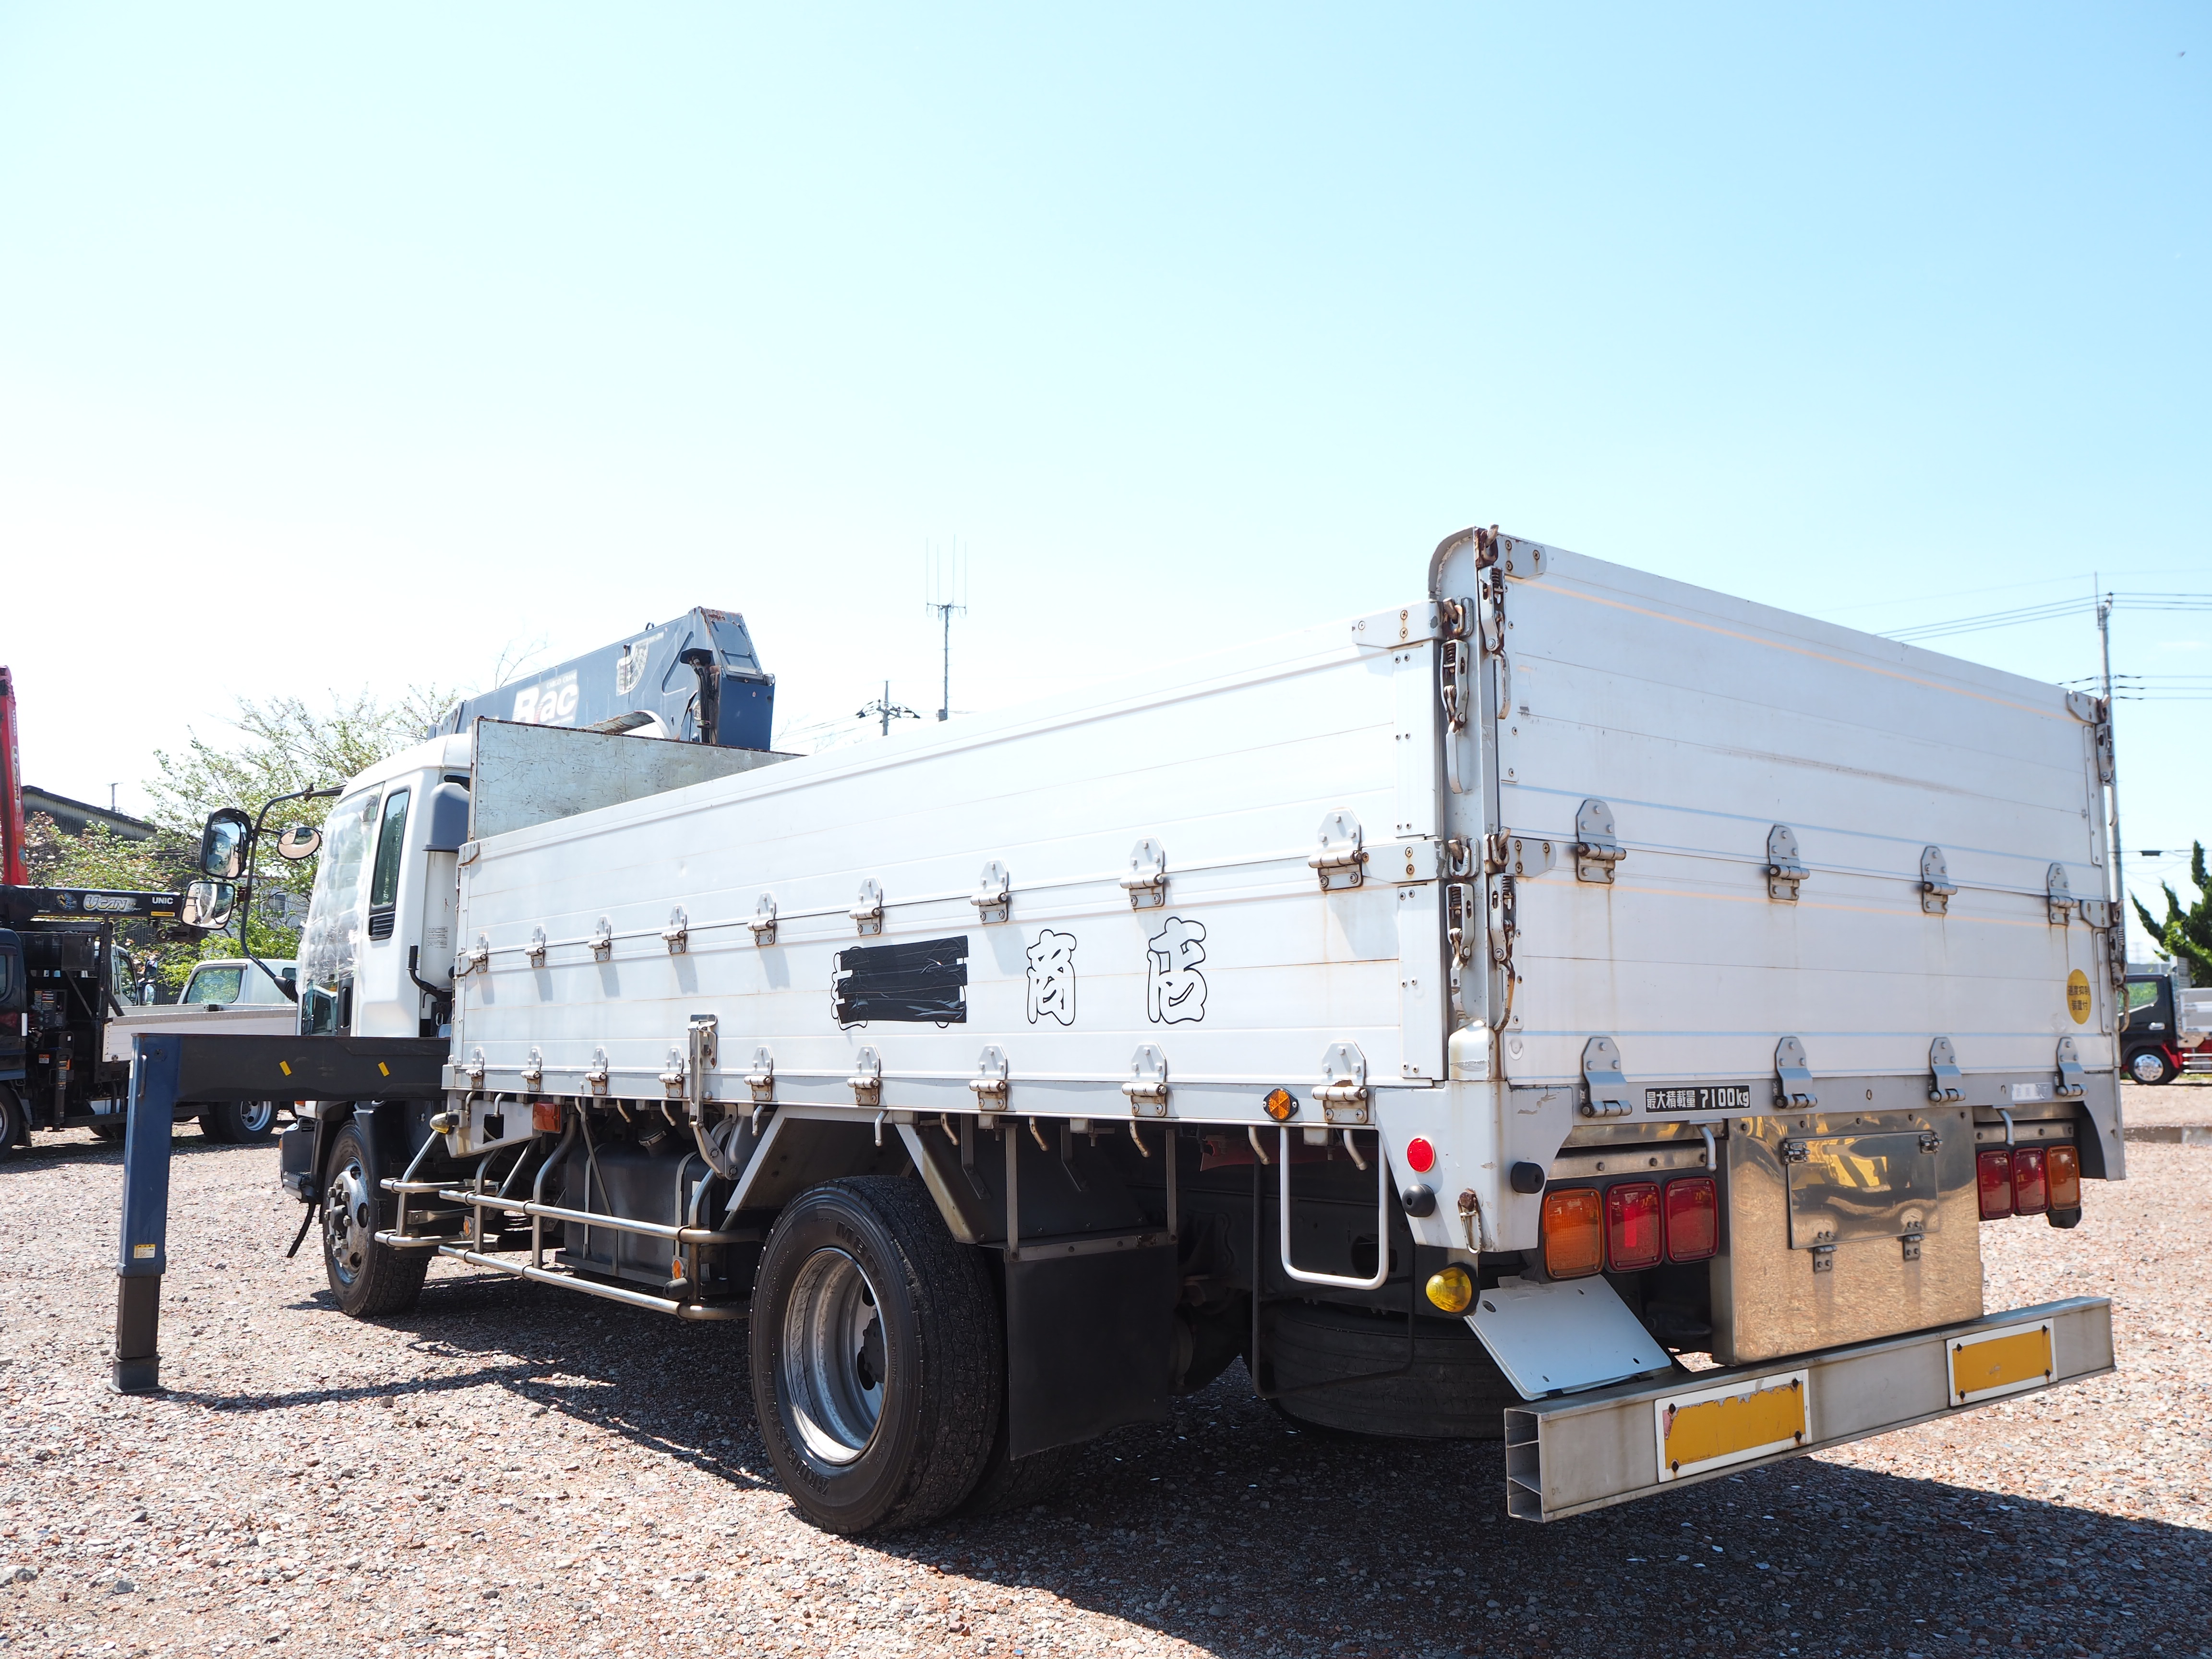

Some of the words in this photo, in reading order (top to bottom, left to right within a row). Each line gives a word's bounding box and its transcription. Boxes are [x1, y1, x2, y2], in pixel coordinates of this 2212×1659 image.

[546, 678, 561, 689] CARGO
[152, 897, 174, 905] UNIC
[2068, 986, 2090, 996] 速度抑制
[2072, 1000, 2088, 1010] 装置付
[1646, 1090, 1696, 1109] 最大積載量
[1700, 1088, 1749, 1108] 7100kg
